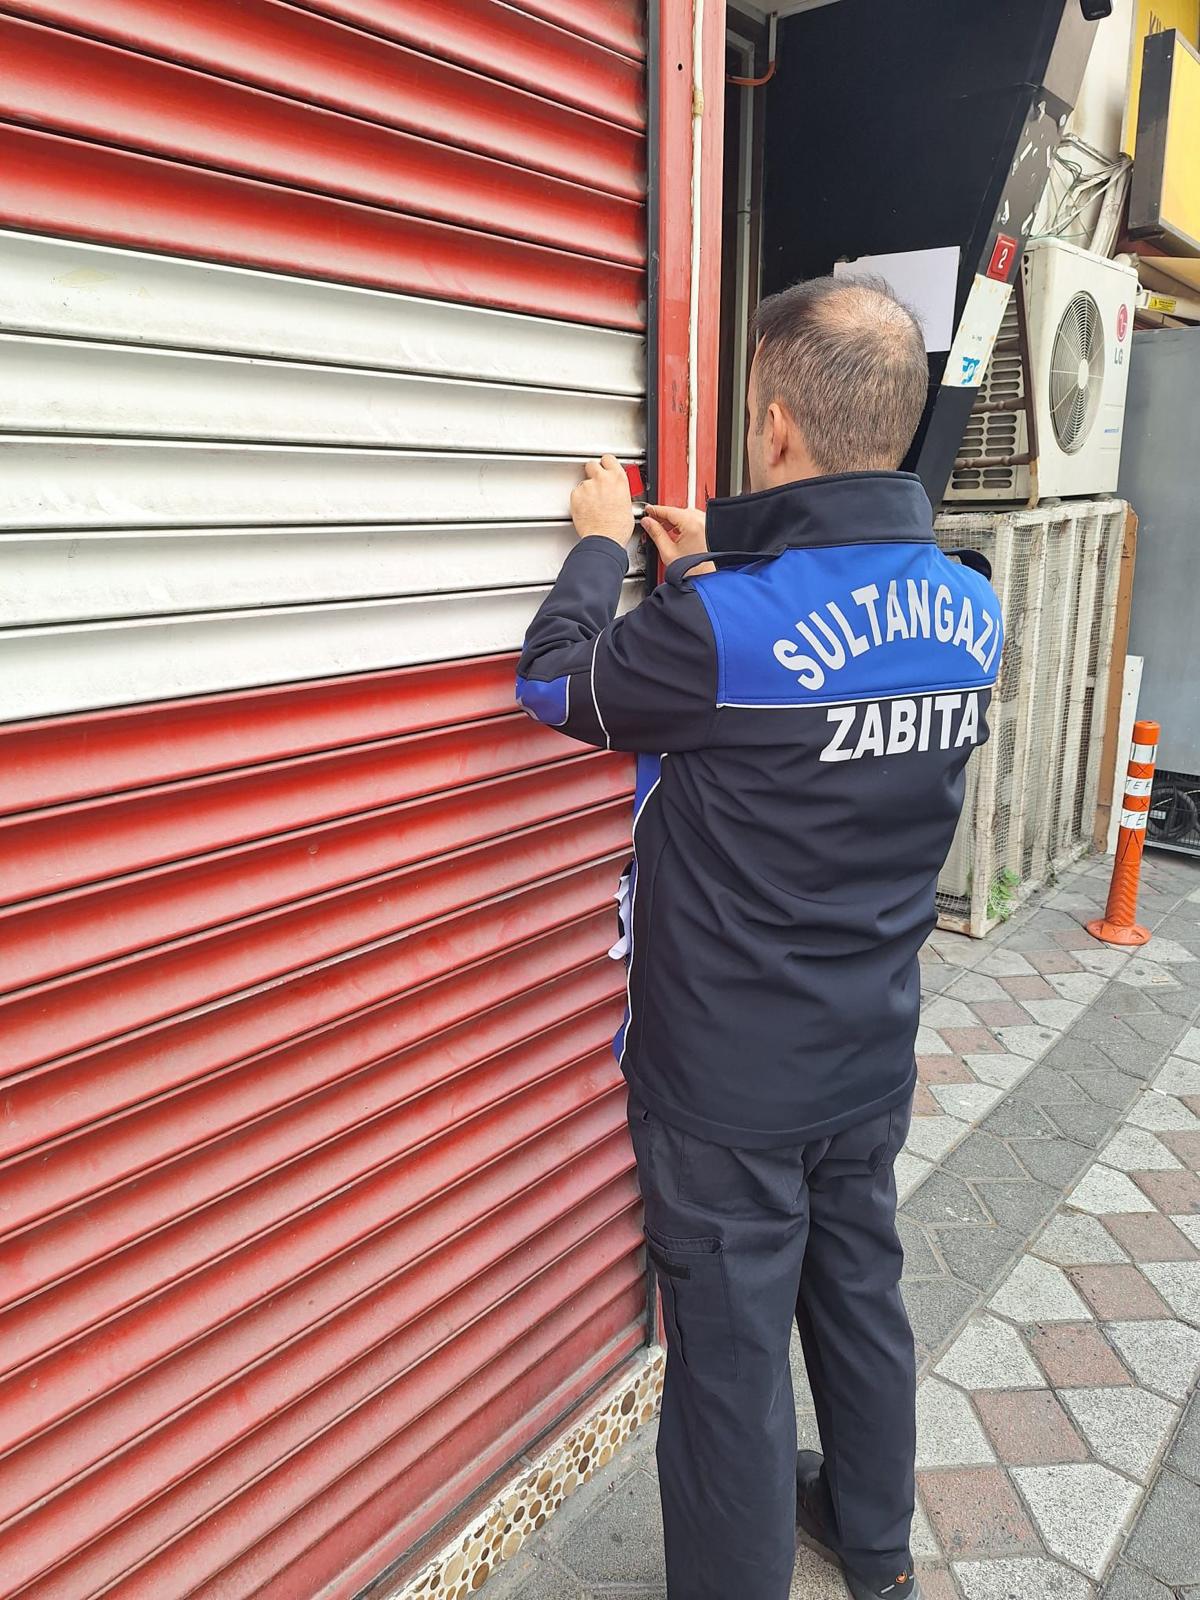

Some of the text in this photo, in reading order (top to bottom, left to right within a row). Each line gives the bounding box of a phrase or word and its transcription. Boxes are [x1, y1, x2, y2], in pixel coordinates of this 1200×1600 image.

[998, 248, 1009, 269] 2
[1114, 347, 1124, 365] LG
[818, 693, 979, 762] ZABITA
